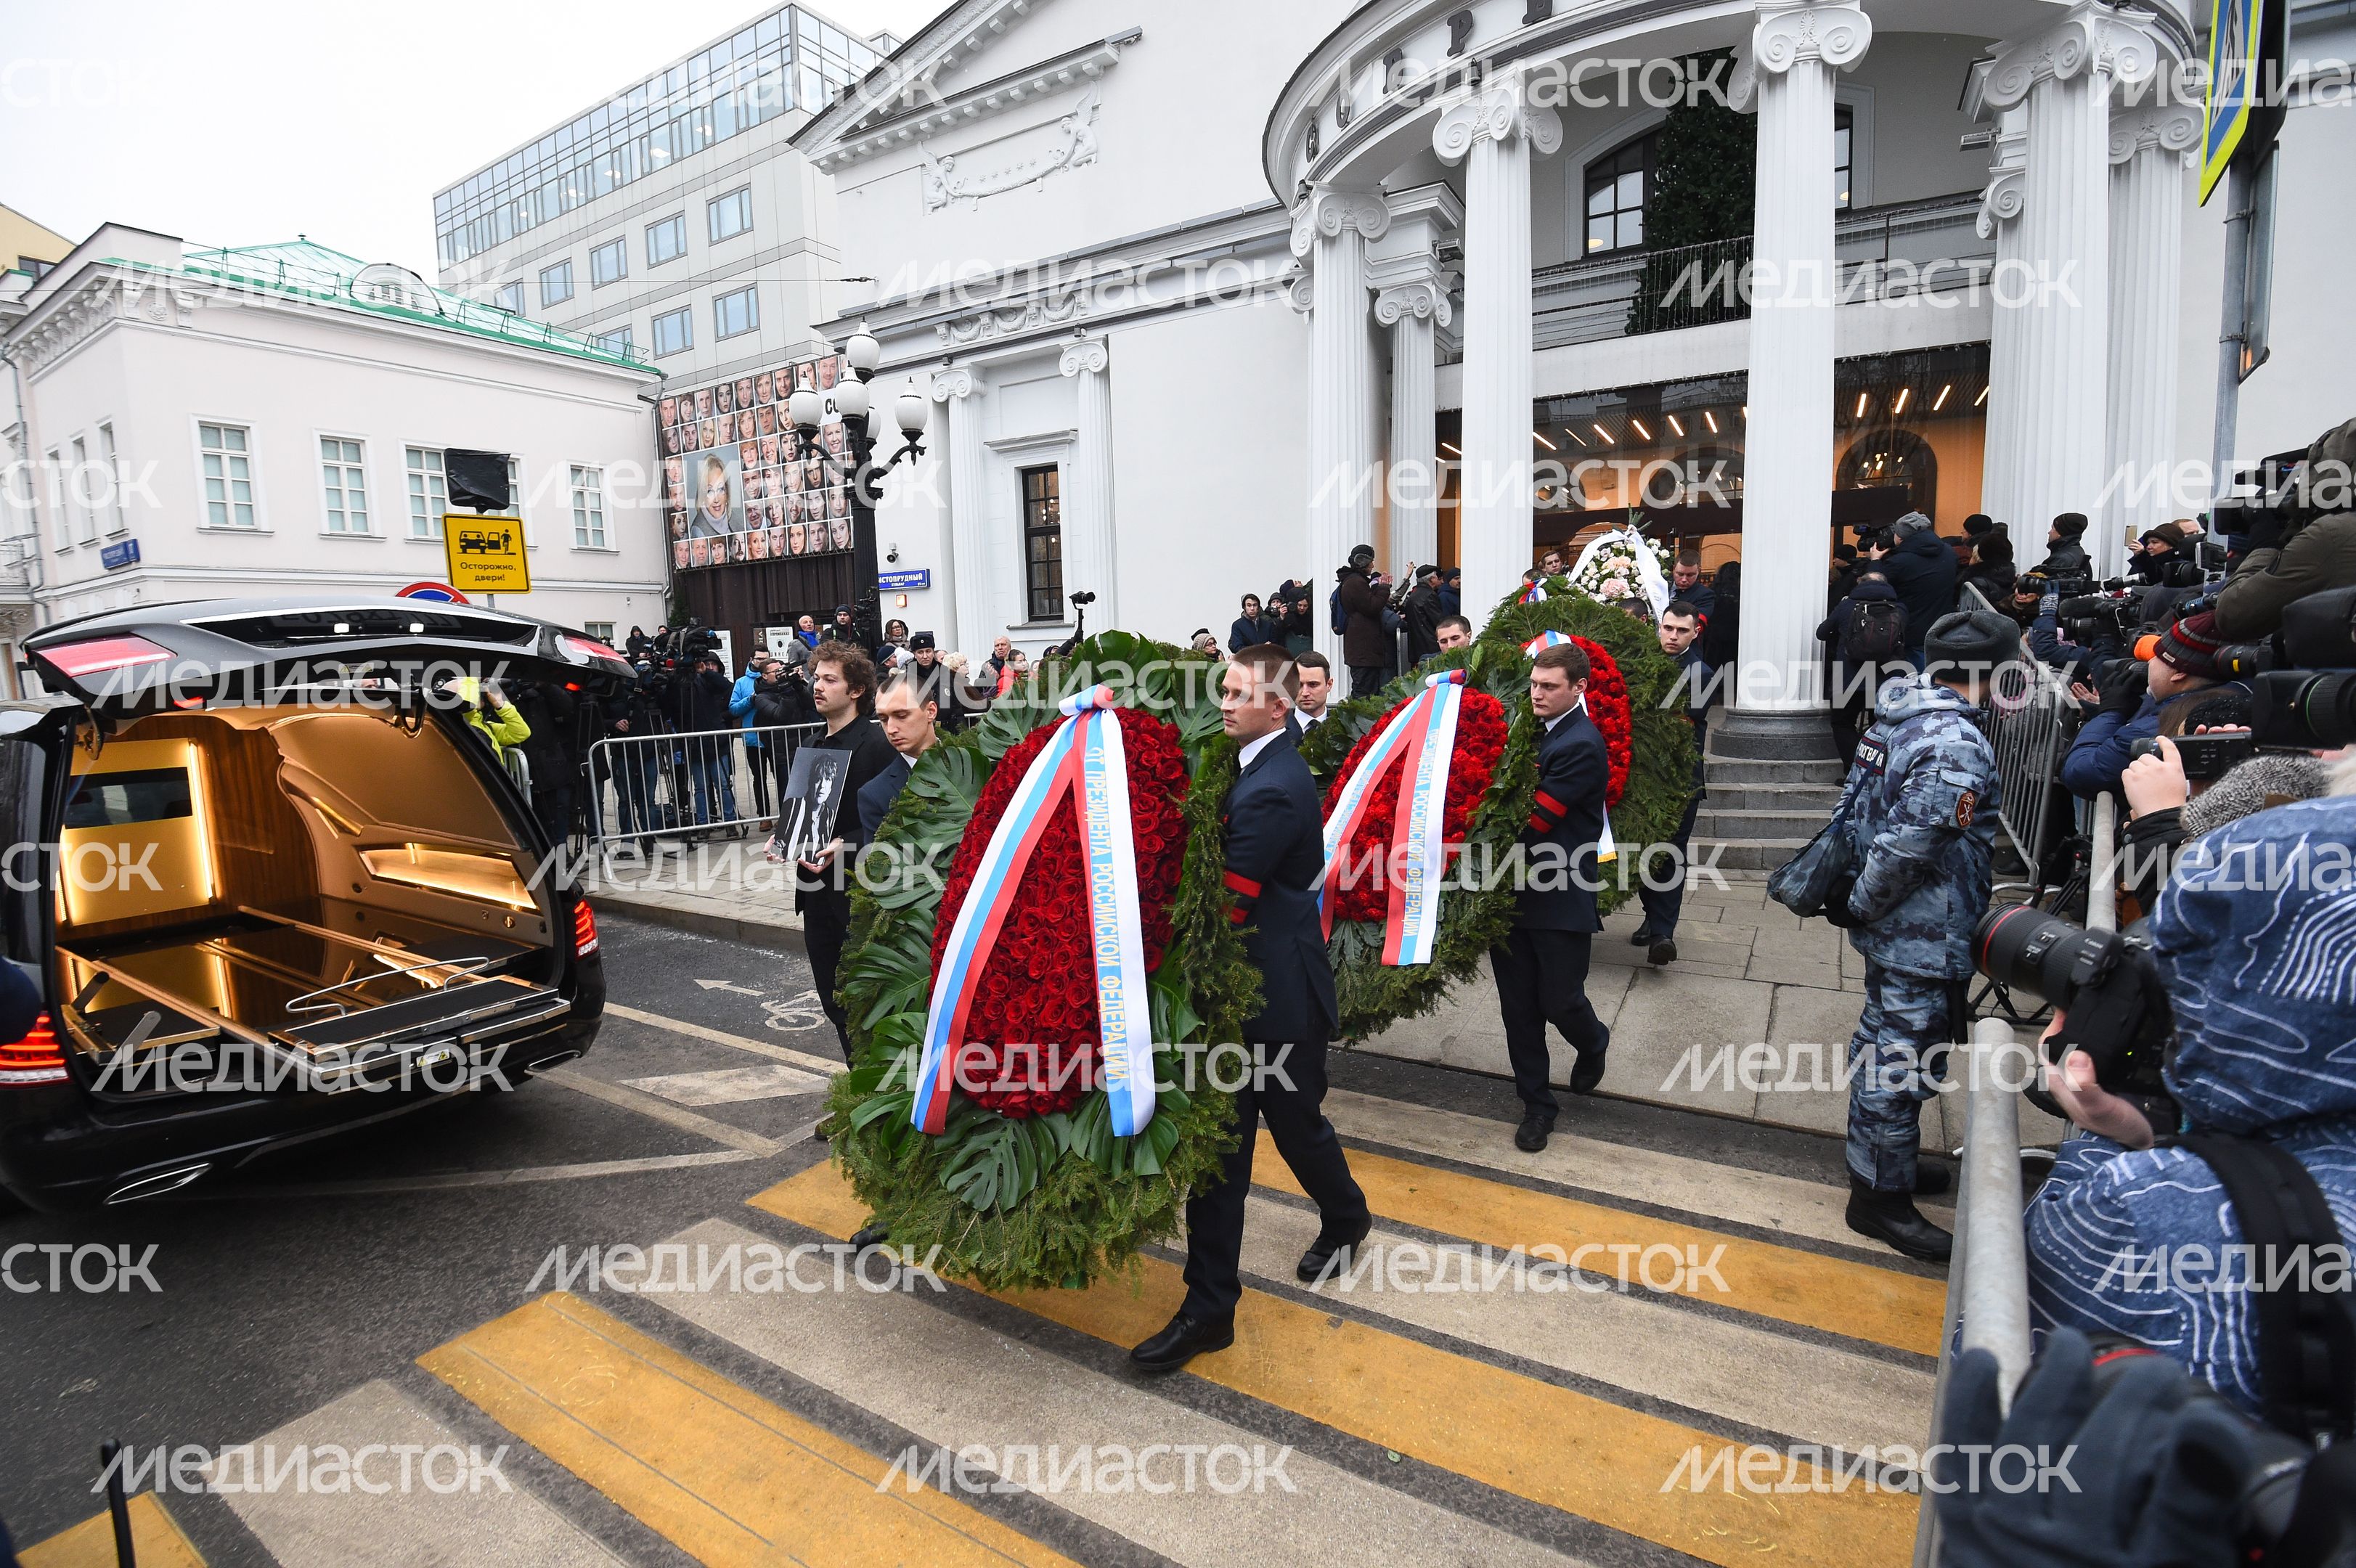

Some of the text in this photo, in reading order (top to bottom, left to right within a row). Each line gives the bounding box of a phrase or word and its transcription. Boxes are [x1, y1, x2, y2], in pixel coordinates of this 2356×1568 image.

[460, 562, 516, 571] Осторожно,
[878, 572, 923, 584] ИСТОПРУДНЫЙ
[1084, 747, 1130, 1080] ОТ ПРЕЗИДЕНТА РОССИЙСКОЙ ФЕДЕРАЦИИ
[1401, 867, 1423, 936] ФЕДЕРАЦИИ
